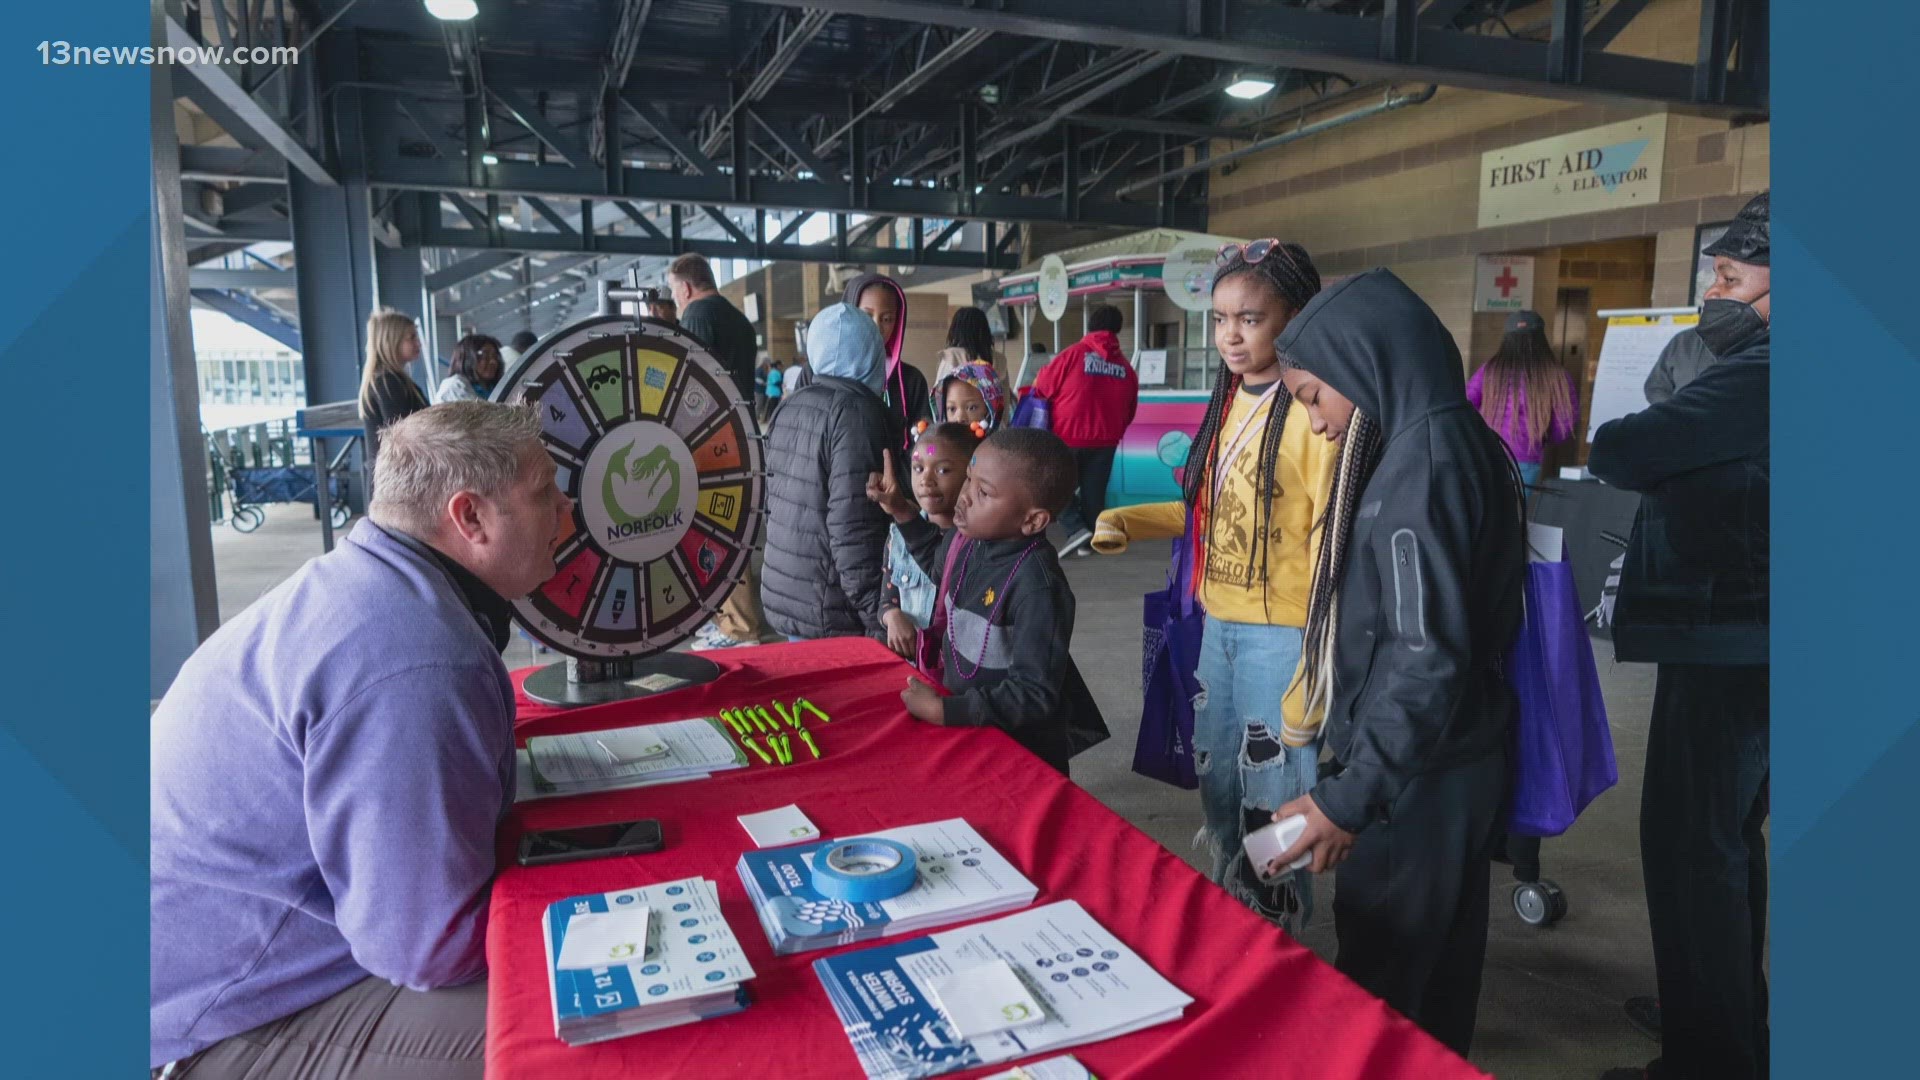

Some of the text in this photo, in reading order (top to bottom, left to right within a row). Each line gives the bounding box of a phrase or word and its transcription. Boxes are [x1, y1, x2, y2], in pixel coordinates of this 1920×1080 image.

[1489, 147, 1603, 188] FIRST AID
[1572, 167, 1648, 192] ELEVATOR
[1085, 359, 1126, 378] KNIGHTS
[550, 405, 566, 423] 4
[713, 443, 728, 457] 3
[606, 511, 684, 540] NORFOLK
[662, 585, 675, 604] 2
[780, 864, 804, 888] FLOOD
[861, 971, 898, 1012] WINTER
[879, 969, 916, 1006] STORM
